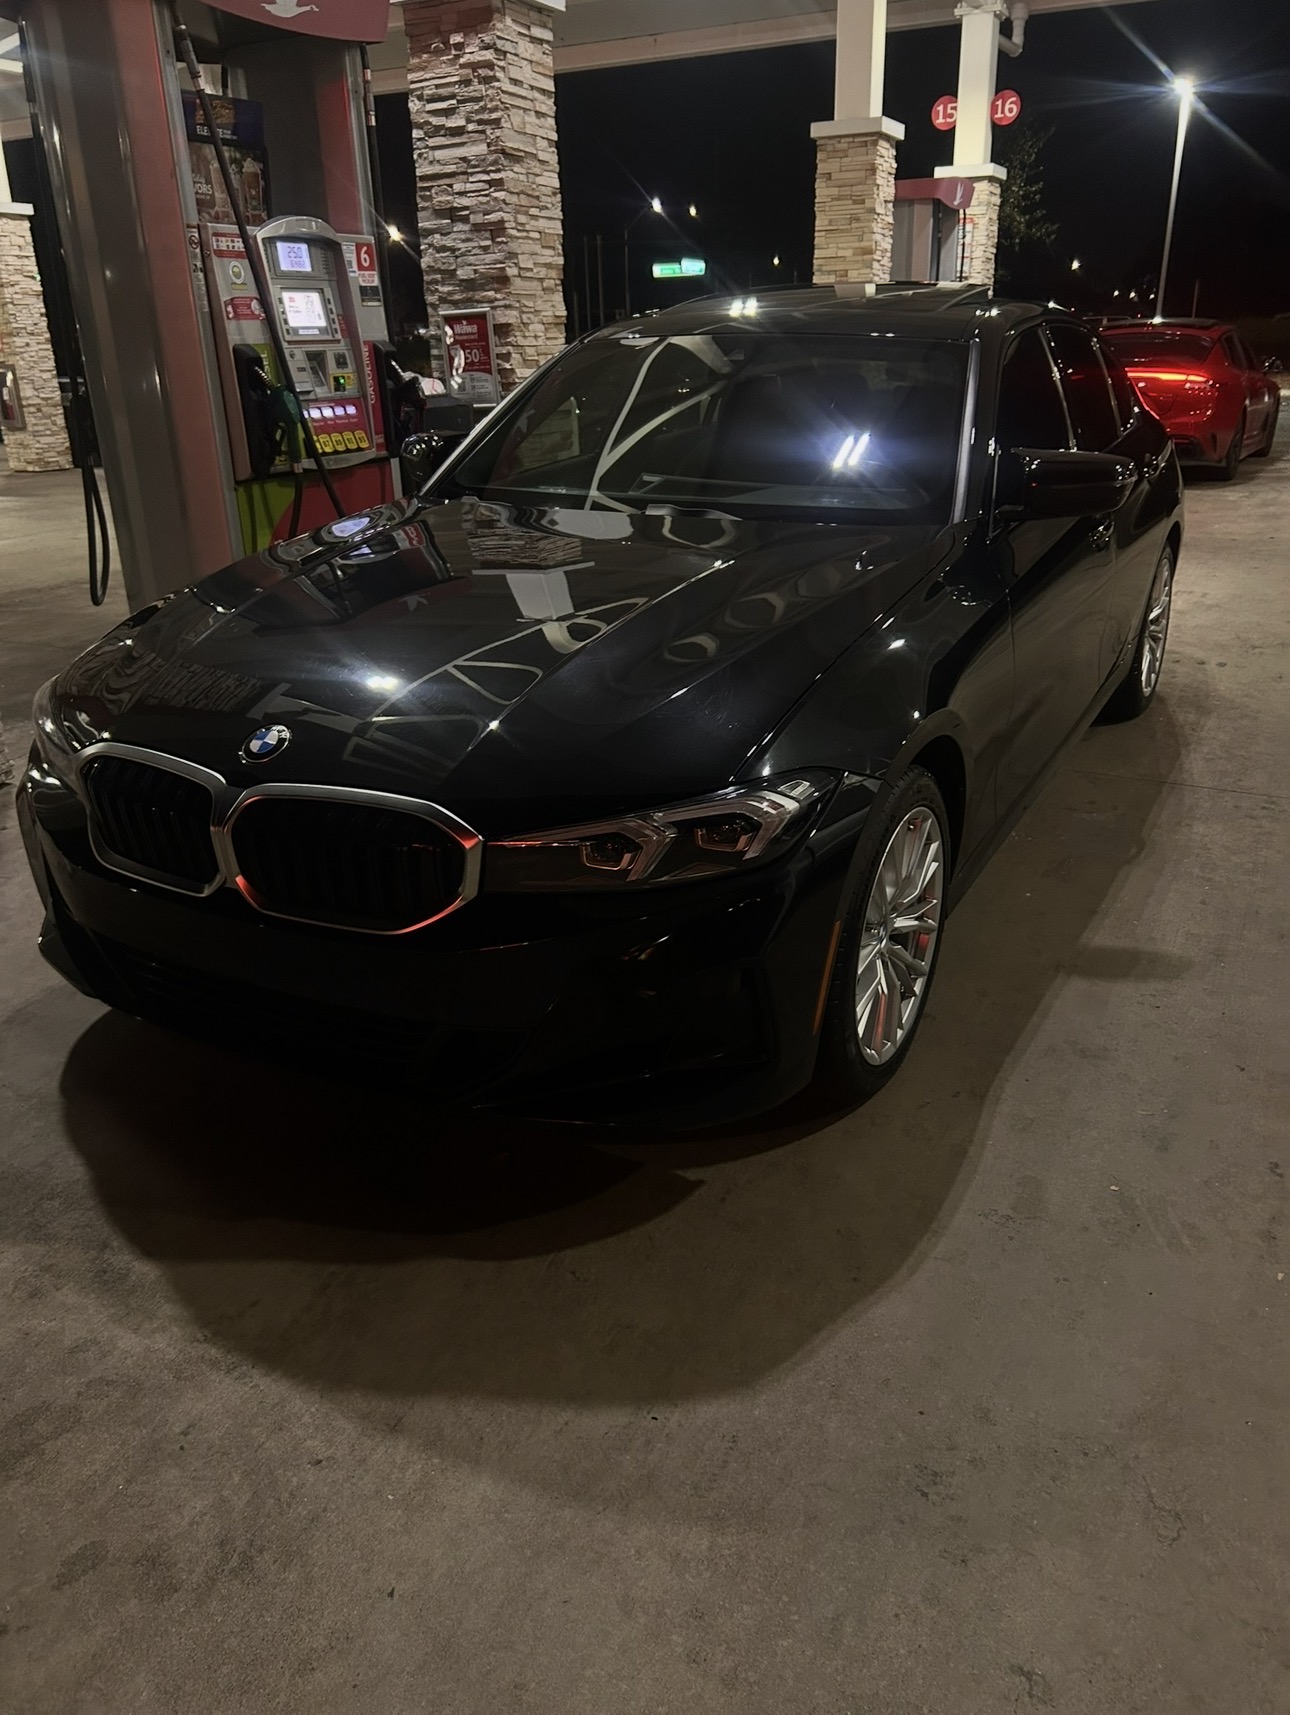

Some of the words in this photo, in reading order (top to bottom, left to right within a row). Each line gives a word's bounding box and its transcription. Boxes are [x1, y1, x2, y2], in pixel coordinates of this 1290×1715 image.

[936, 103, 957, 123] 15
[994, 97, 1017, 118] 16
[196, 125, 223, 138] ELETE
[361, 246, 370, 267] 6
[453, 324, 478, 334] Wawa
[362, 344, 376, 404] GASOLINE
